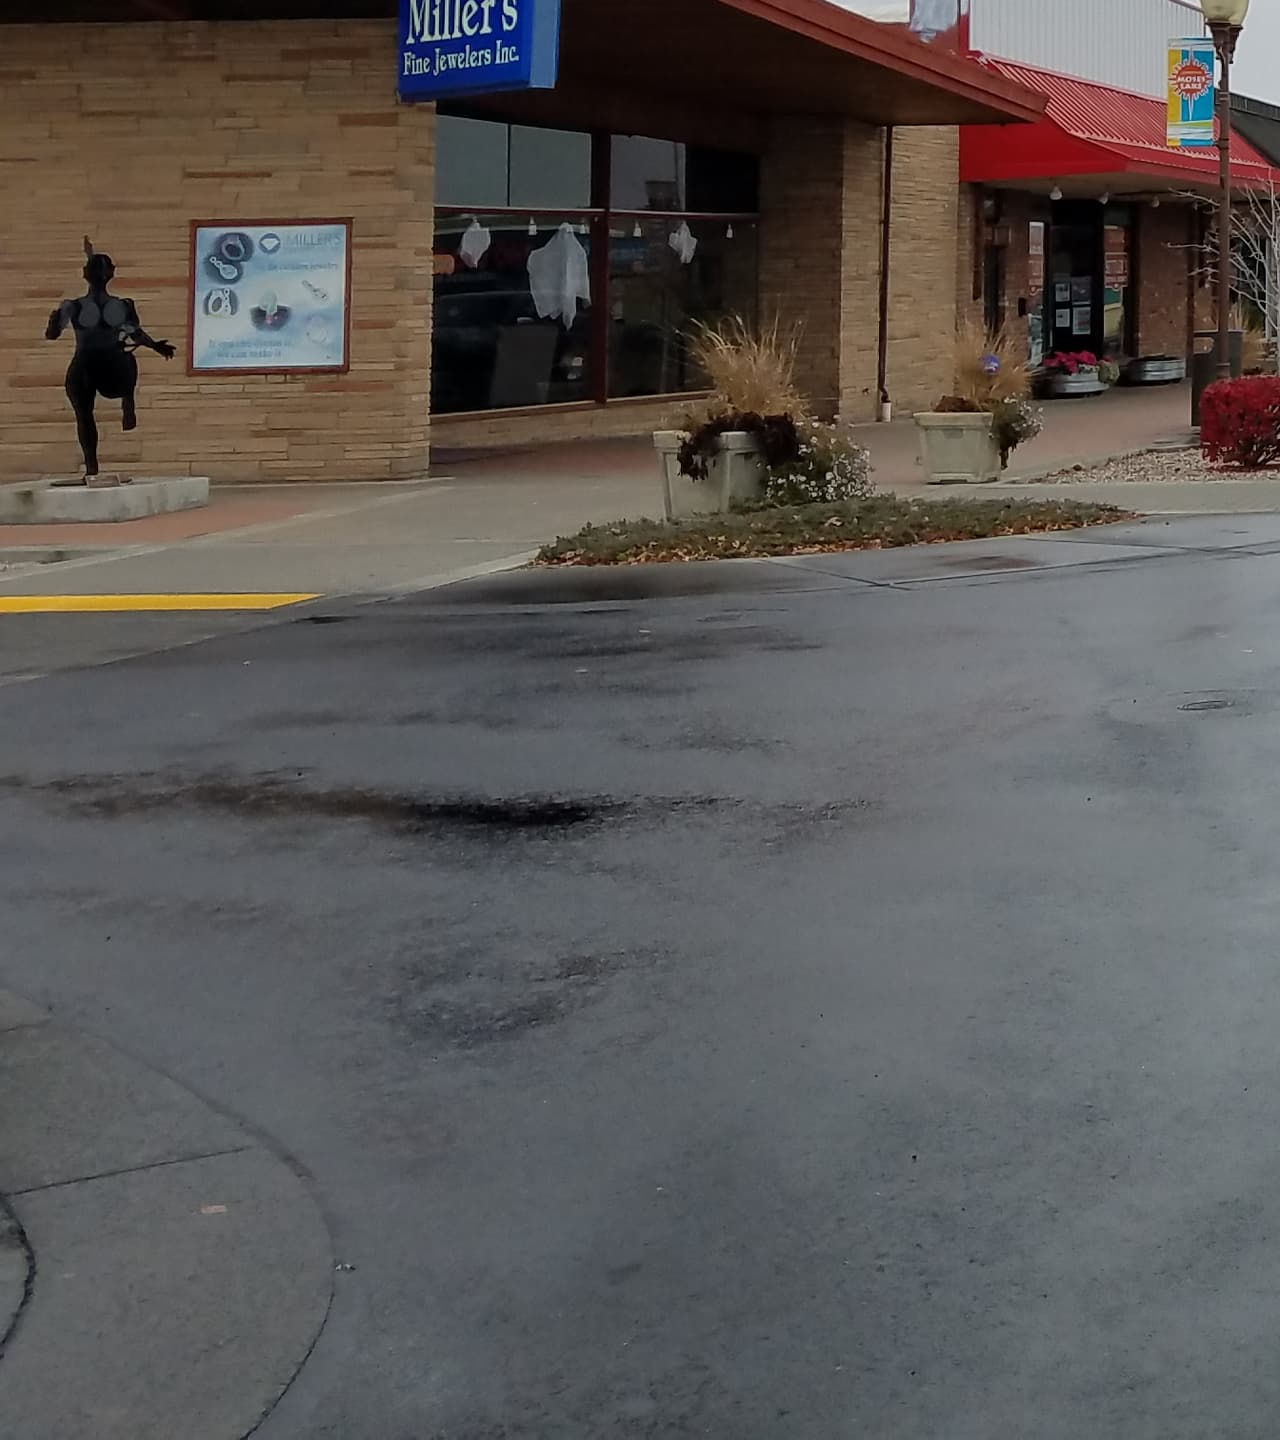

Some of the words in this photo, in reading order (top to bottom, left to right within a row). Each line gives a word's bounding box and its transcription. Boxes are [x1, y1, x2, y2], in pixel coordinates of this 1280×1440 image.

[402, 51, 431, 76] Fine
[433, 44, 492, 76] Jewelers
[495, 39, 520, 65] Inc.
